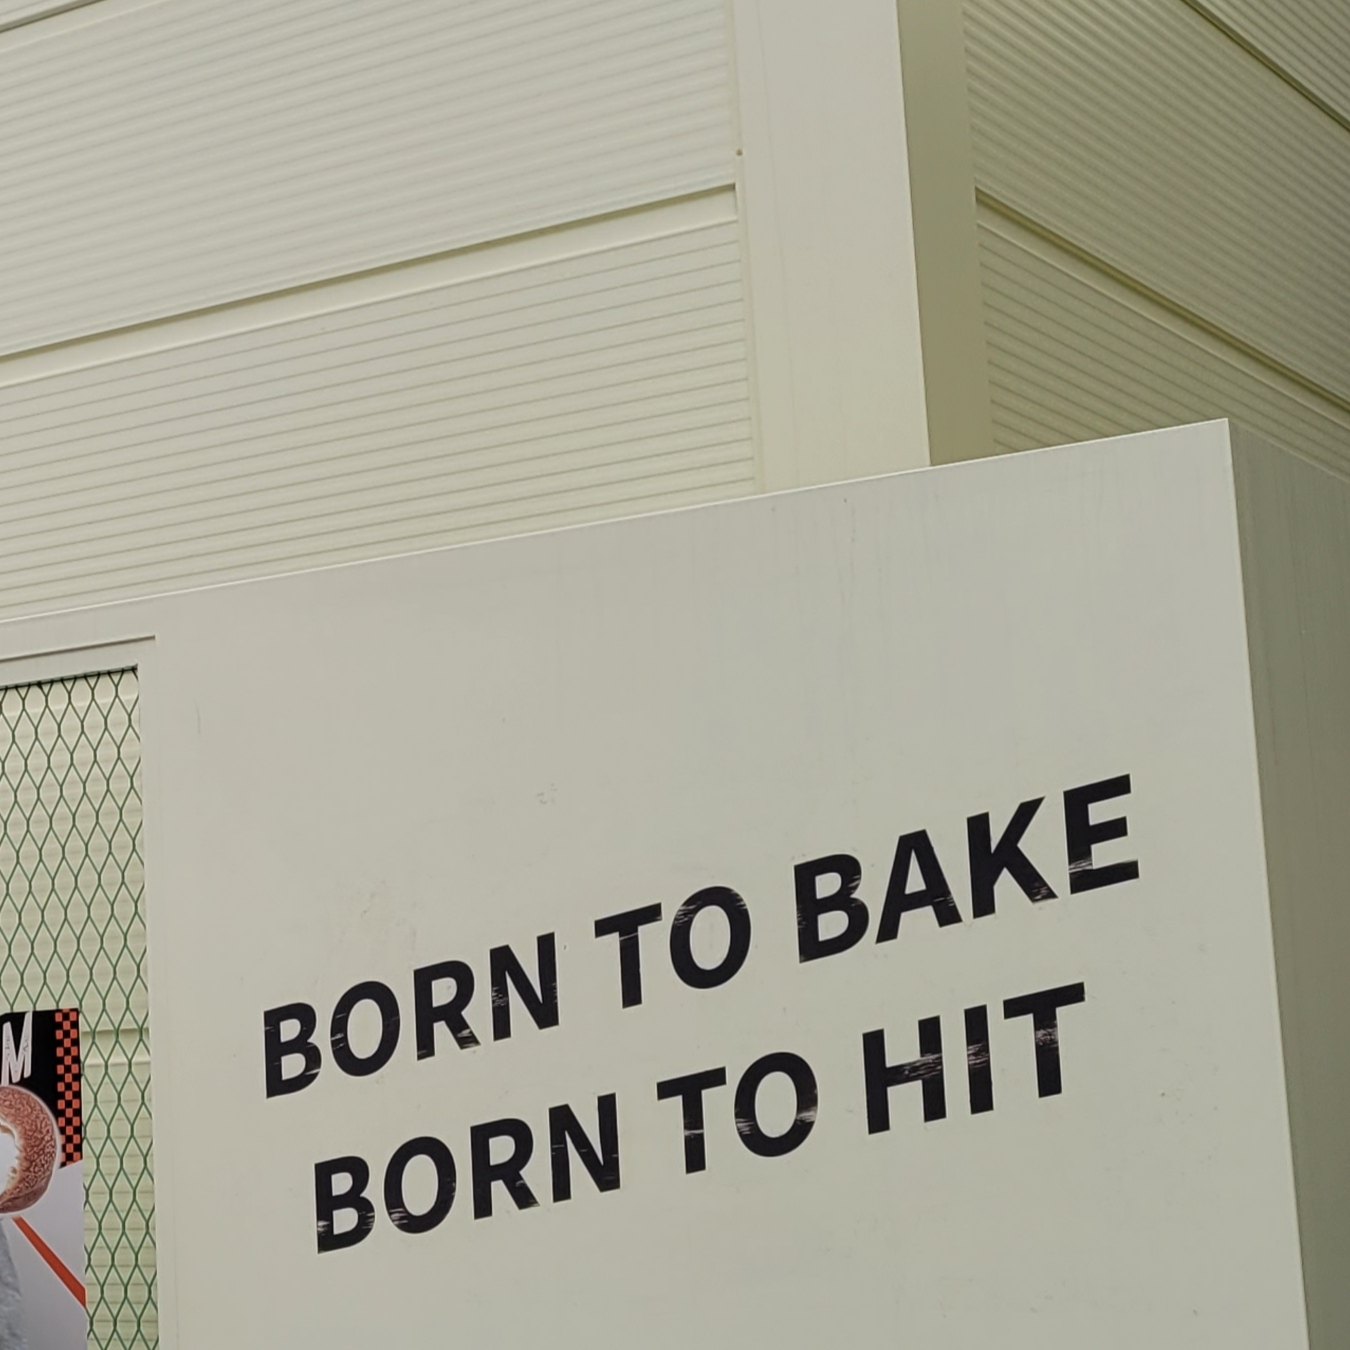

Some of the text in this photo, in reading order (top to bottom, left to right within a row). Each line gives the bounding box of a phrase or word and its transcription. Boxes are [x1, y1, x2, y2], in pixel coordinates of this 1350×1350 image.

[264, 774, 1140, 1098] BORN TO BAKE
[315, 982, 1086, 1254] BORN TO HIT
